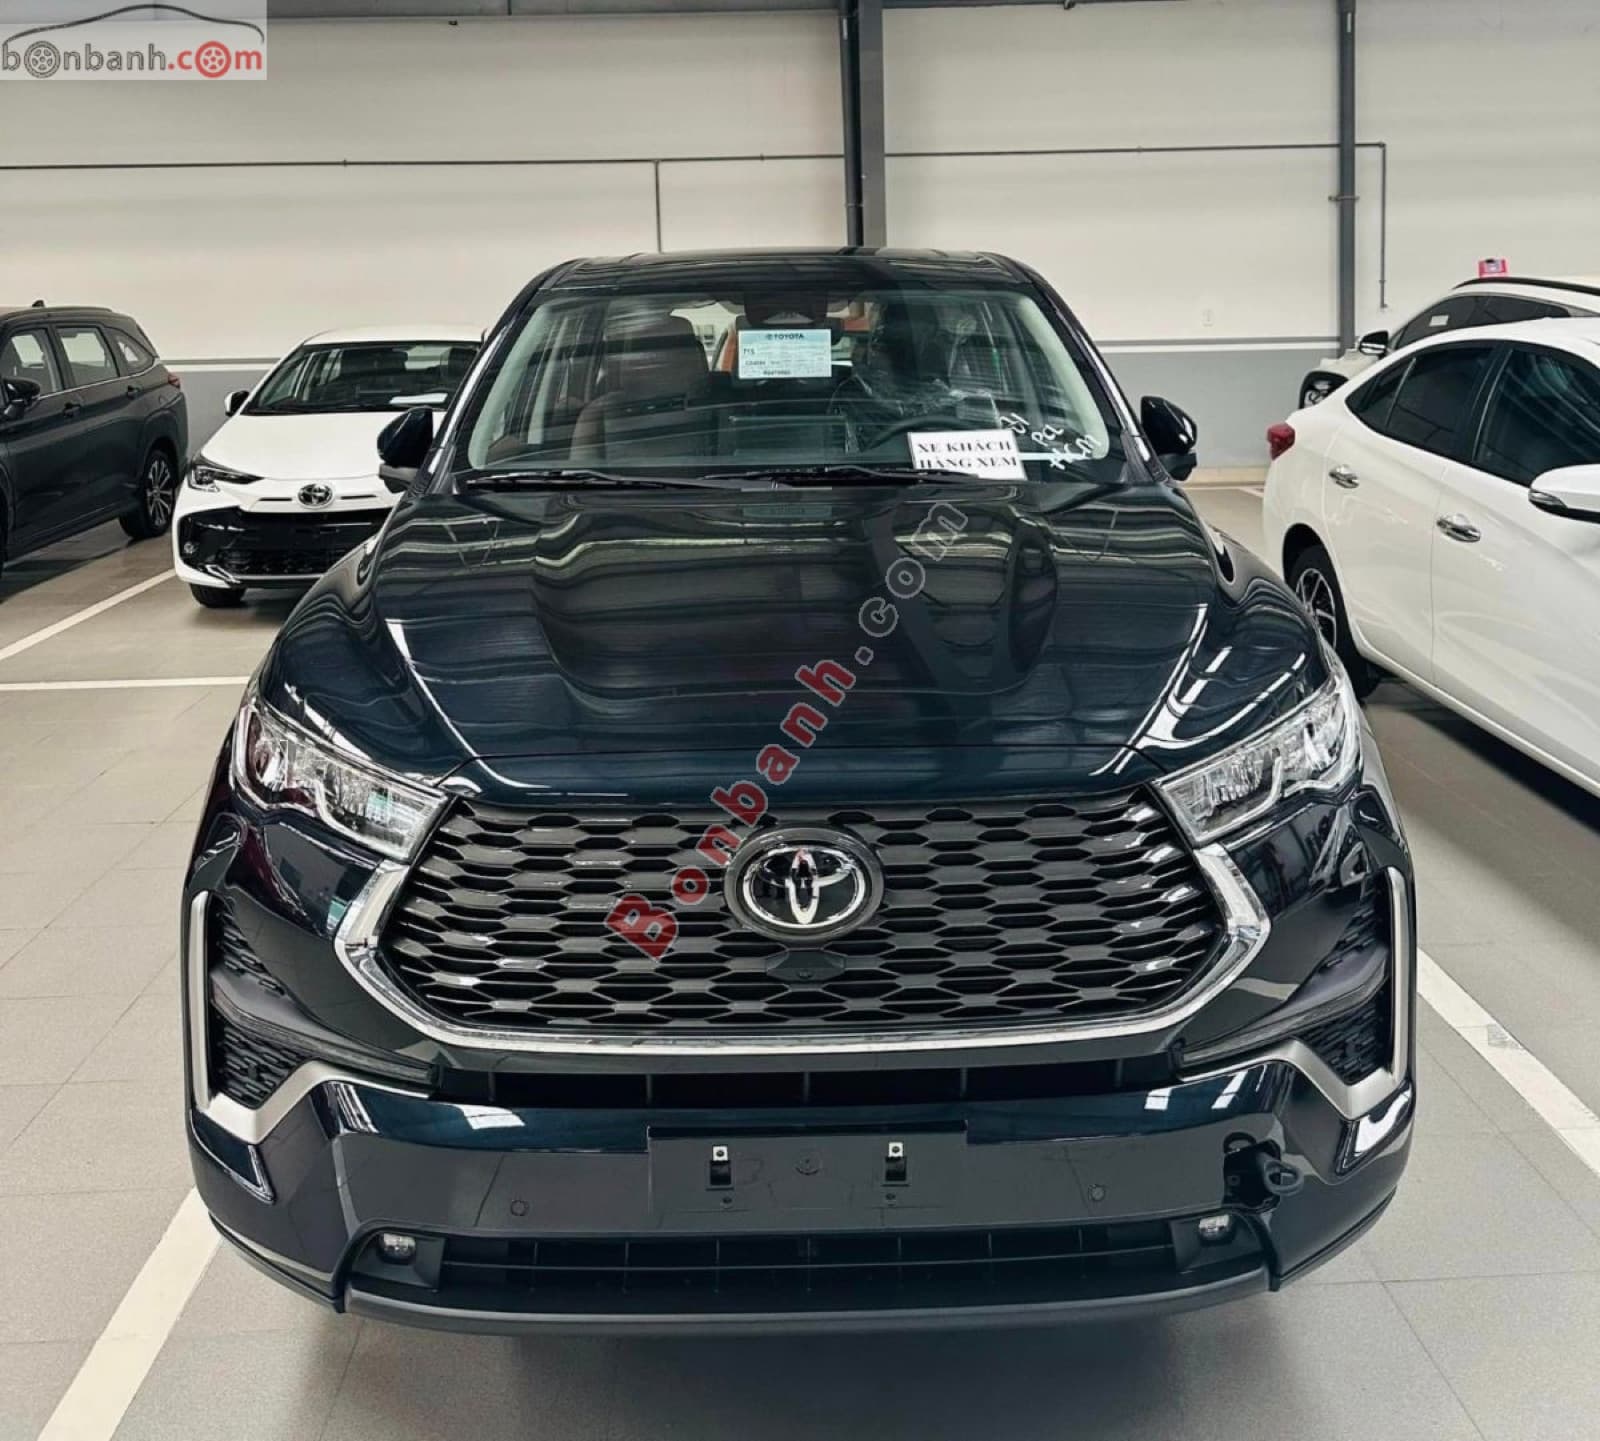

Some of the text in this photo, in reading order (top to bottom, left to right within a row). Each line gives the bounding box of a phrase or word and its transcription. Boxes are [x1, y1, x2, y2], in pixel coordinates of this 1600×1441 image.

[917, 439, 1012, 453] XE KHÁCH
[977, 455, 1018, 467] XEM
